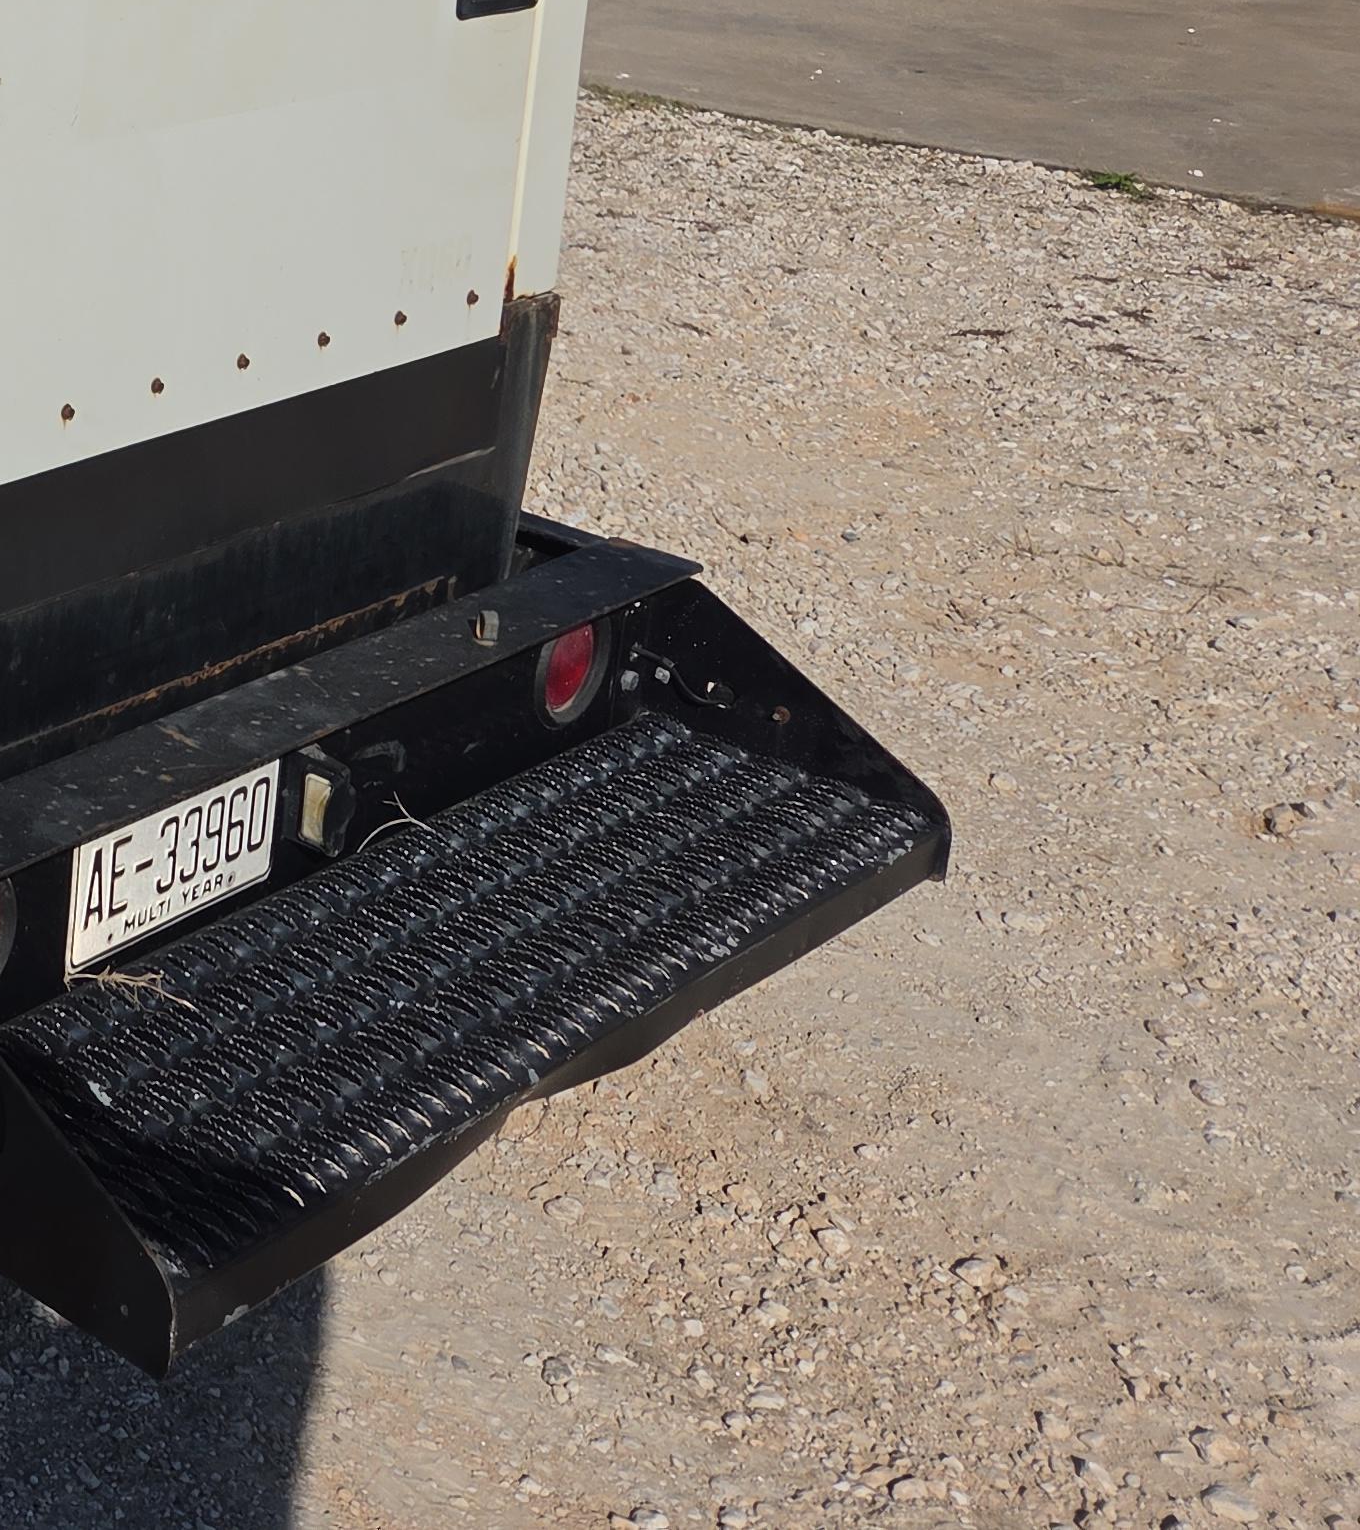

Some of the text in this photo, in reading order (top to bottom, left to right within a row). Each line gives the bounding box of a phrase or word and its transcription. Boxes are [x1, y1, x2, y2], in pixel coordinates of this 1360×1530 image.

[82, 776, 271, 931] AE-33960
[122, 873, 224, 936] MULTI YEAR
